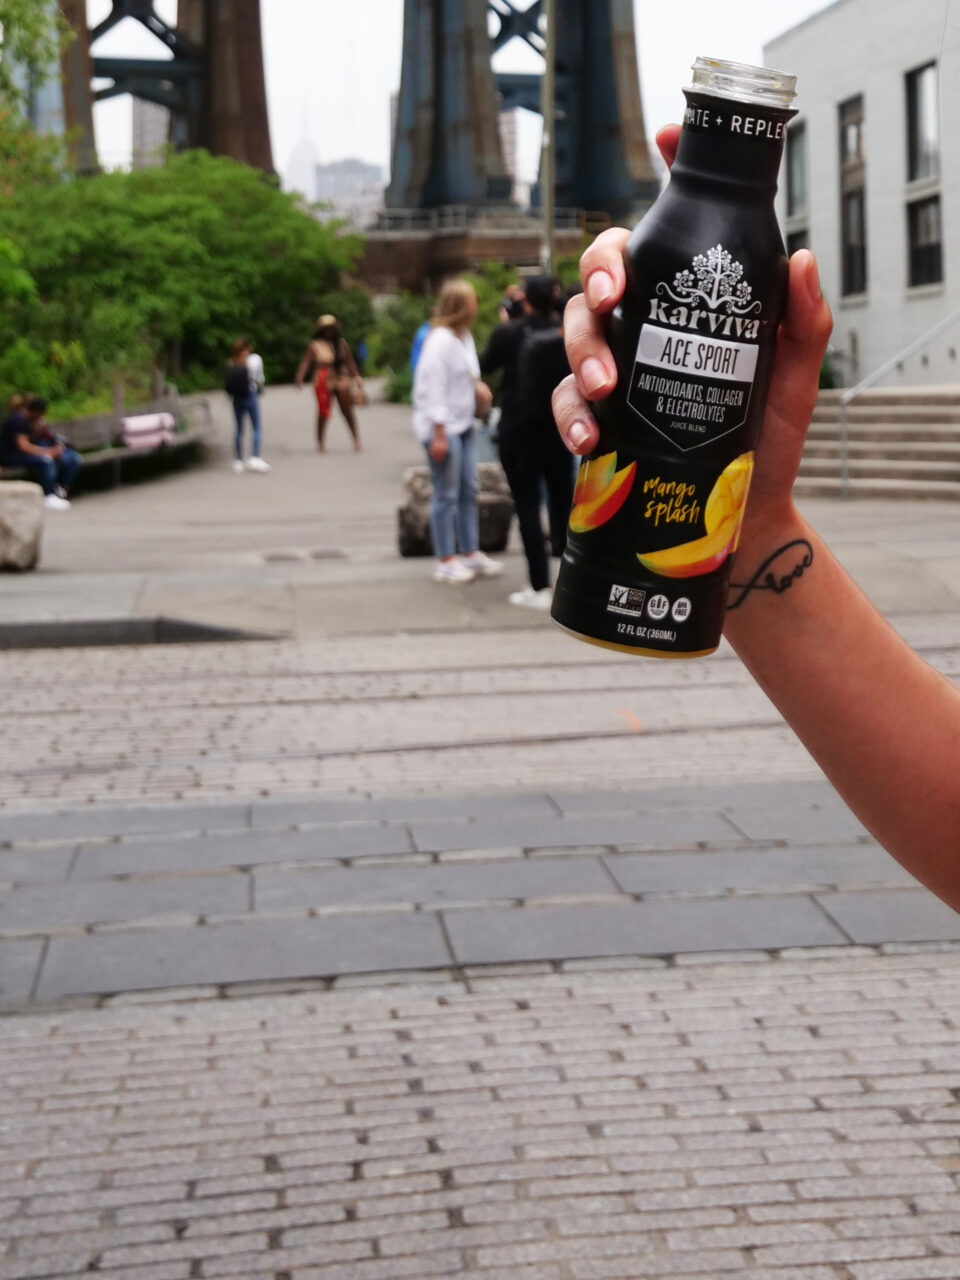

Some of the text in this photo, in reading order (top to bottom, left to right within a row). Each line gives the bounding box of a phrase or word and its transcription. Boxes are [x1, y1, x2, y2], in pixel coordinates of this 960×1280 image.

[715, 115, 723, 126] +
[730, 115, 784, 139] REPLE
[660, 336, 741, 375] ACE SPORT
[638, 373, 745, 407] ANTIOXIDANTS, COLLAGEN
[656, 395, 726, 423] & ELECTROLYTES
[669, 420, 707, 434] JUICE BLEND
[644, 500, 700, 527] splash
[674, 608, 688, 617] FREE
[617, 623, 626, 633] 12
[626, 624, 635, 635] FL
[636, 626, 647, 637] OZ
